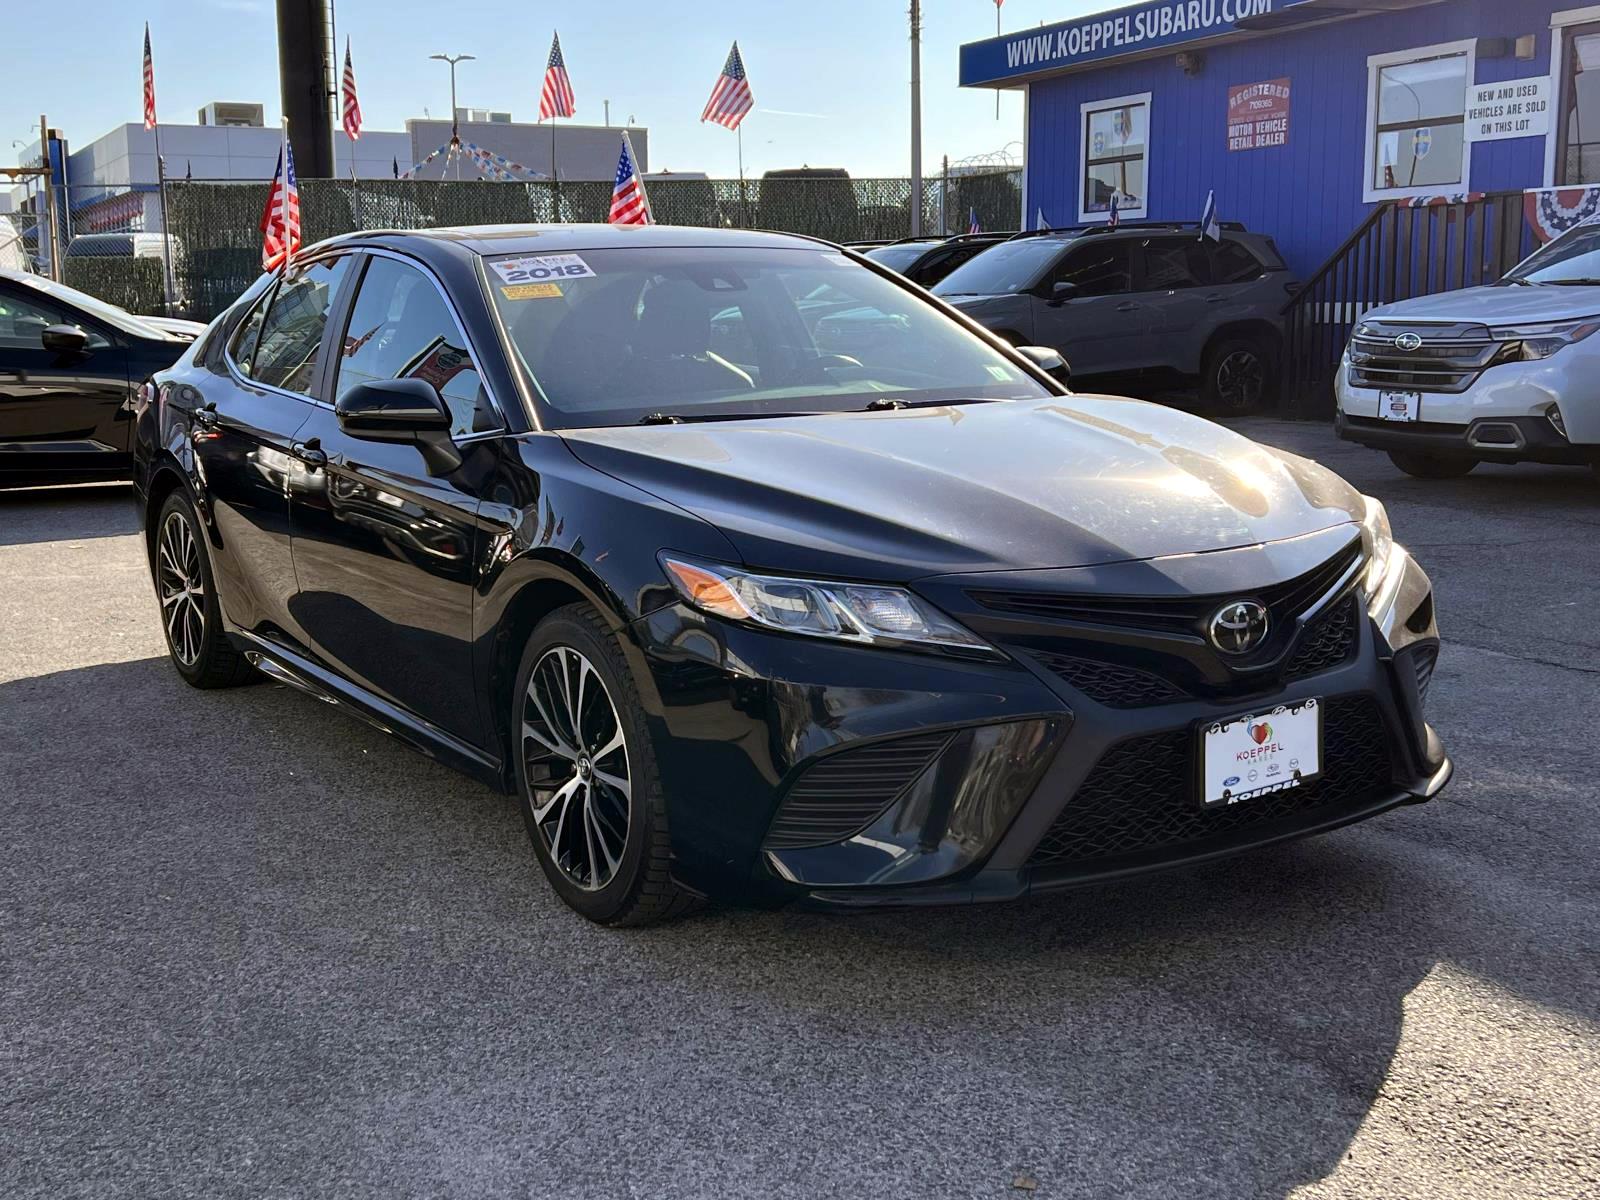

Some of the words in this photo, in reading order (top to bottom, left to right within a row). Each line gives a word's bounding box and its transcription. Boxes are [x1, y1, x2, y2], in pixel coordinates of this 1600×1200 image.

[1006, 0, 1272, 68] WWW.KOEPPELSUBARU.COM
[1230, 83, 1290, 109] REGISTERED
[1477, 90, 1494, 102] NEW
[1497, 88, 1514, 100] AND
[1516, 84, 1538, 97] USED
[1468, 106, 1504, 120] VEHICLES
[1507, 103, 1522, 115] ARE
[1525, 100, 1546, 113] SOLD
[1229, 123, 1253, 137] MOTOR
[1256, 118, 1287, 134] VEHICLE
[1481, 123, 1492, 135] ON
[1495, 121, 1512, 133] THIS
[1515, 119, 1530, 131] LOT
[1230, 136, 1253, 151] RETAIL
[1256, 132, 1285, 147] DEALER
[506, 264, 588, 281] 2018
[1236, 743, 1285, 761] KOEPPEL
[1227, 779, 1301, 804] KOEPPEL
